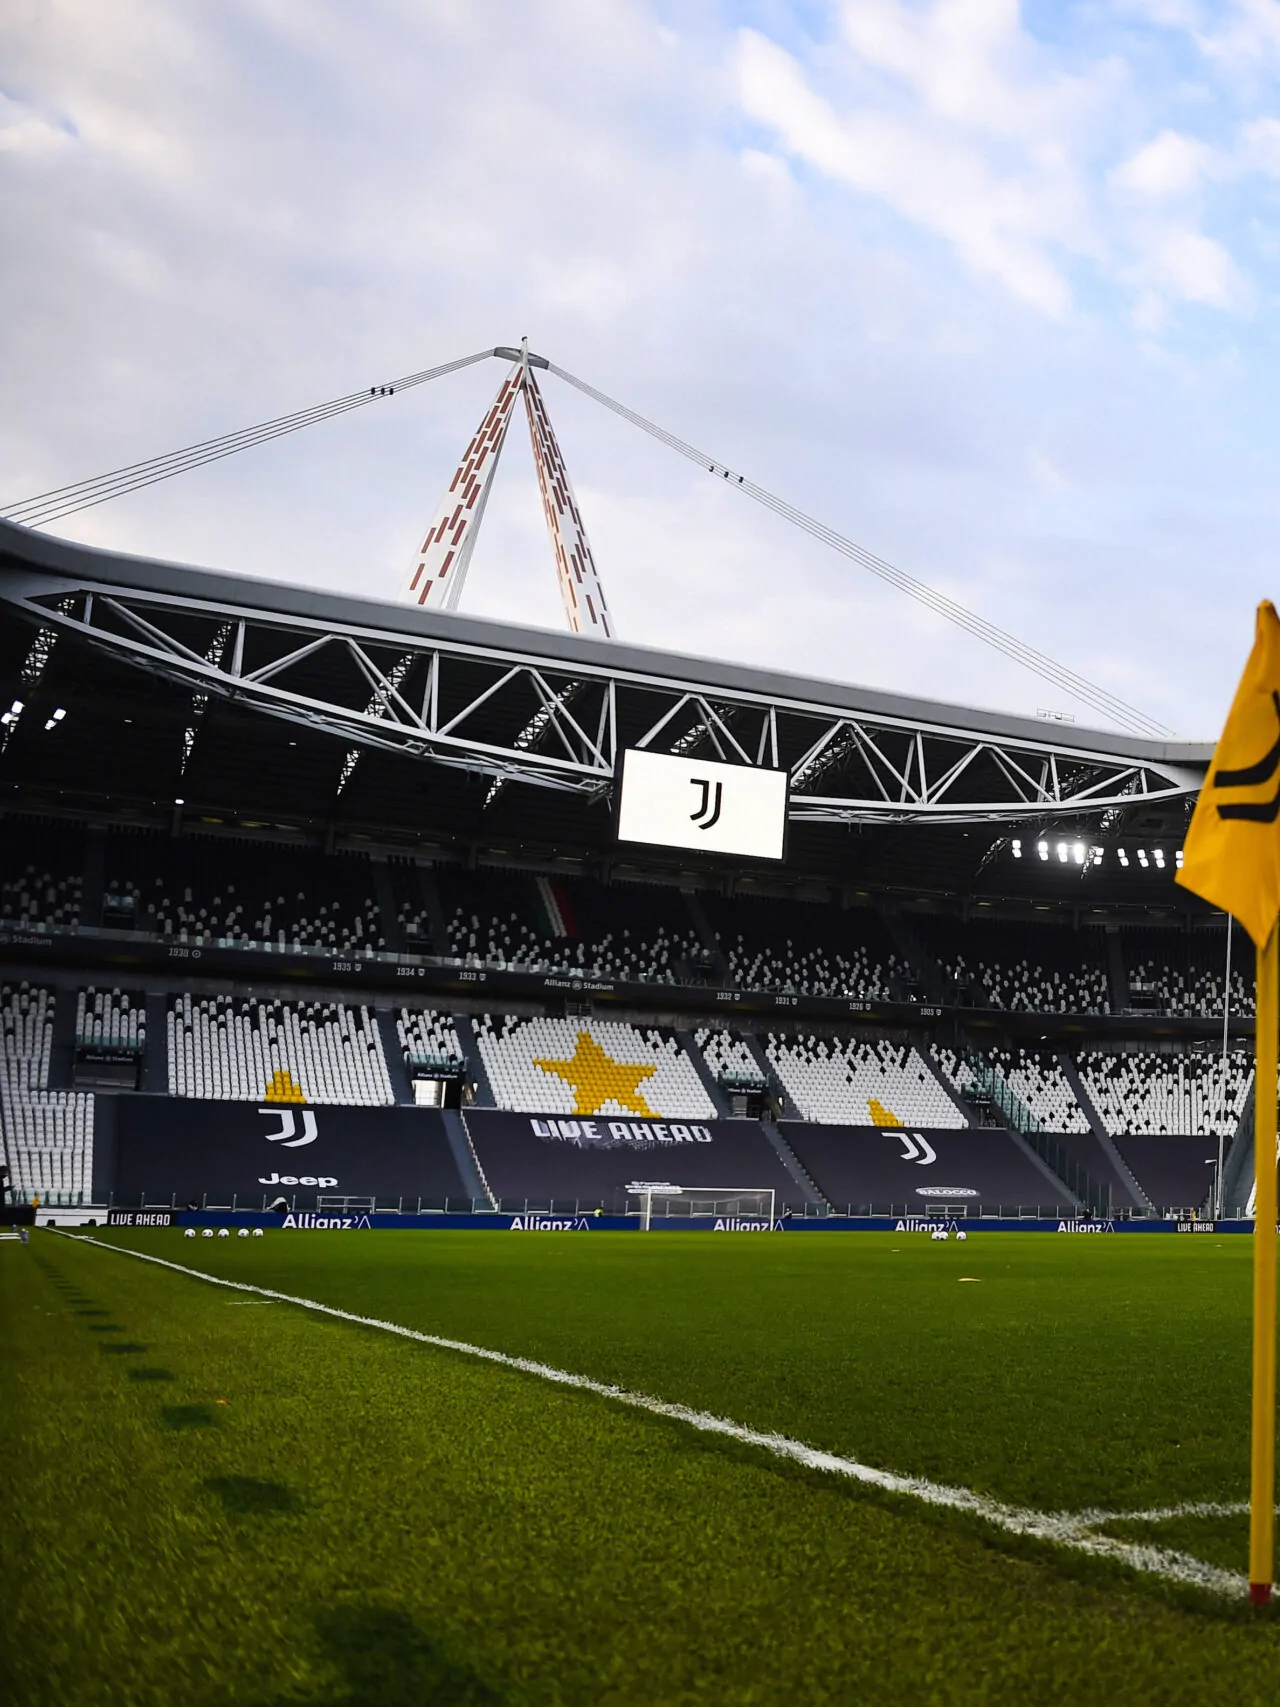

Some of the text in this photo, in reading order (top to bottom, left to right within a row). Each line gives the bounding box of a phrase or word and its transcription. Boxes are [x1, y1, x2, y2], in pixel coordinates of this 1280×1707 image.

[12, 934, 53, 946] Stadium
[396, 967, 415, 976] 1934
[544, 979, 614, 991] Allianz Stadium
[530, 1119, 713, 1143] LIVE AHEAD
[258, 1173, 338, 1187] Jeep
[110, 1212, 171, 1226] LIVE AHEAD
[282, 1213, 352, 1229] Allianz
[510, 1216, 572, 1231] Allianz
[714, 1218, 769, 1232] Allianz
[895, 1219, 945, 1232] Allianz
[1057, 1220, 1102, 1233] Allianz
[1177, 1222, 1214, 1232] LIVE AHEAD
